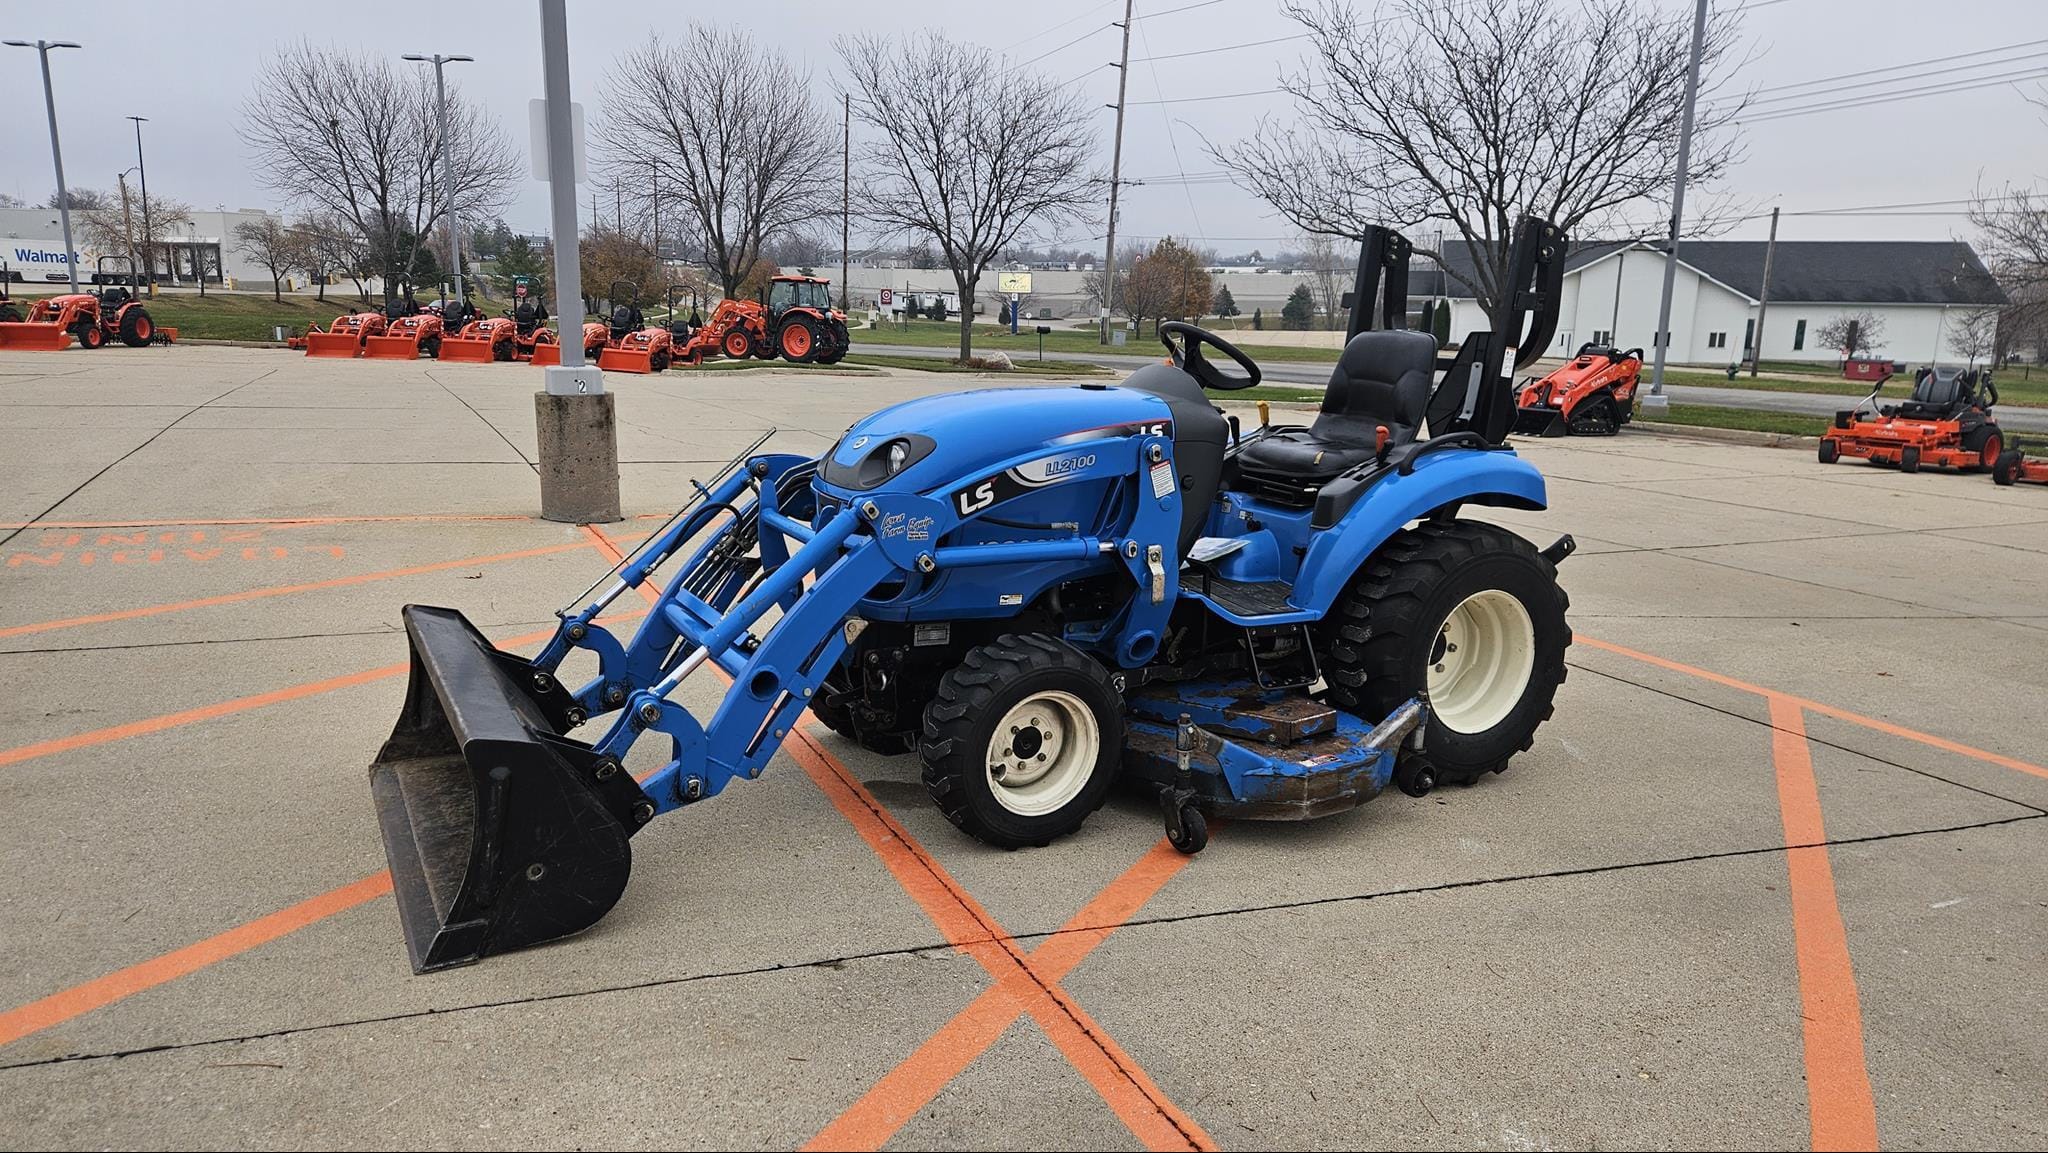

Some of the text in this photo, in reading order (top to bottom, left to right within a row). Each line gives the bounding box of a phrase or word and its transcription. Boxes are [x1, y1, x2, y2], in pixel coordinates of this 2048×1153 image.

[14, 248, 80, 265] Walmat
[579, 380, 586, 394] 2
[1045, 454, 1096, 476] LL2100
[960, 482, 994, 515] LS
